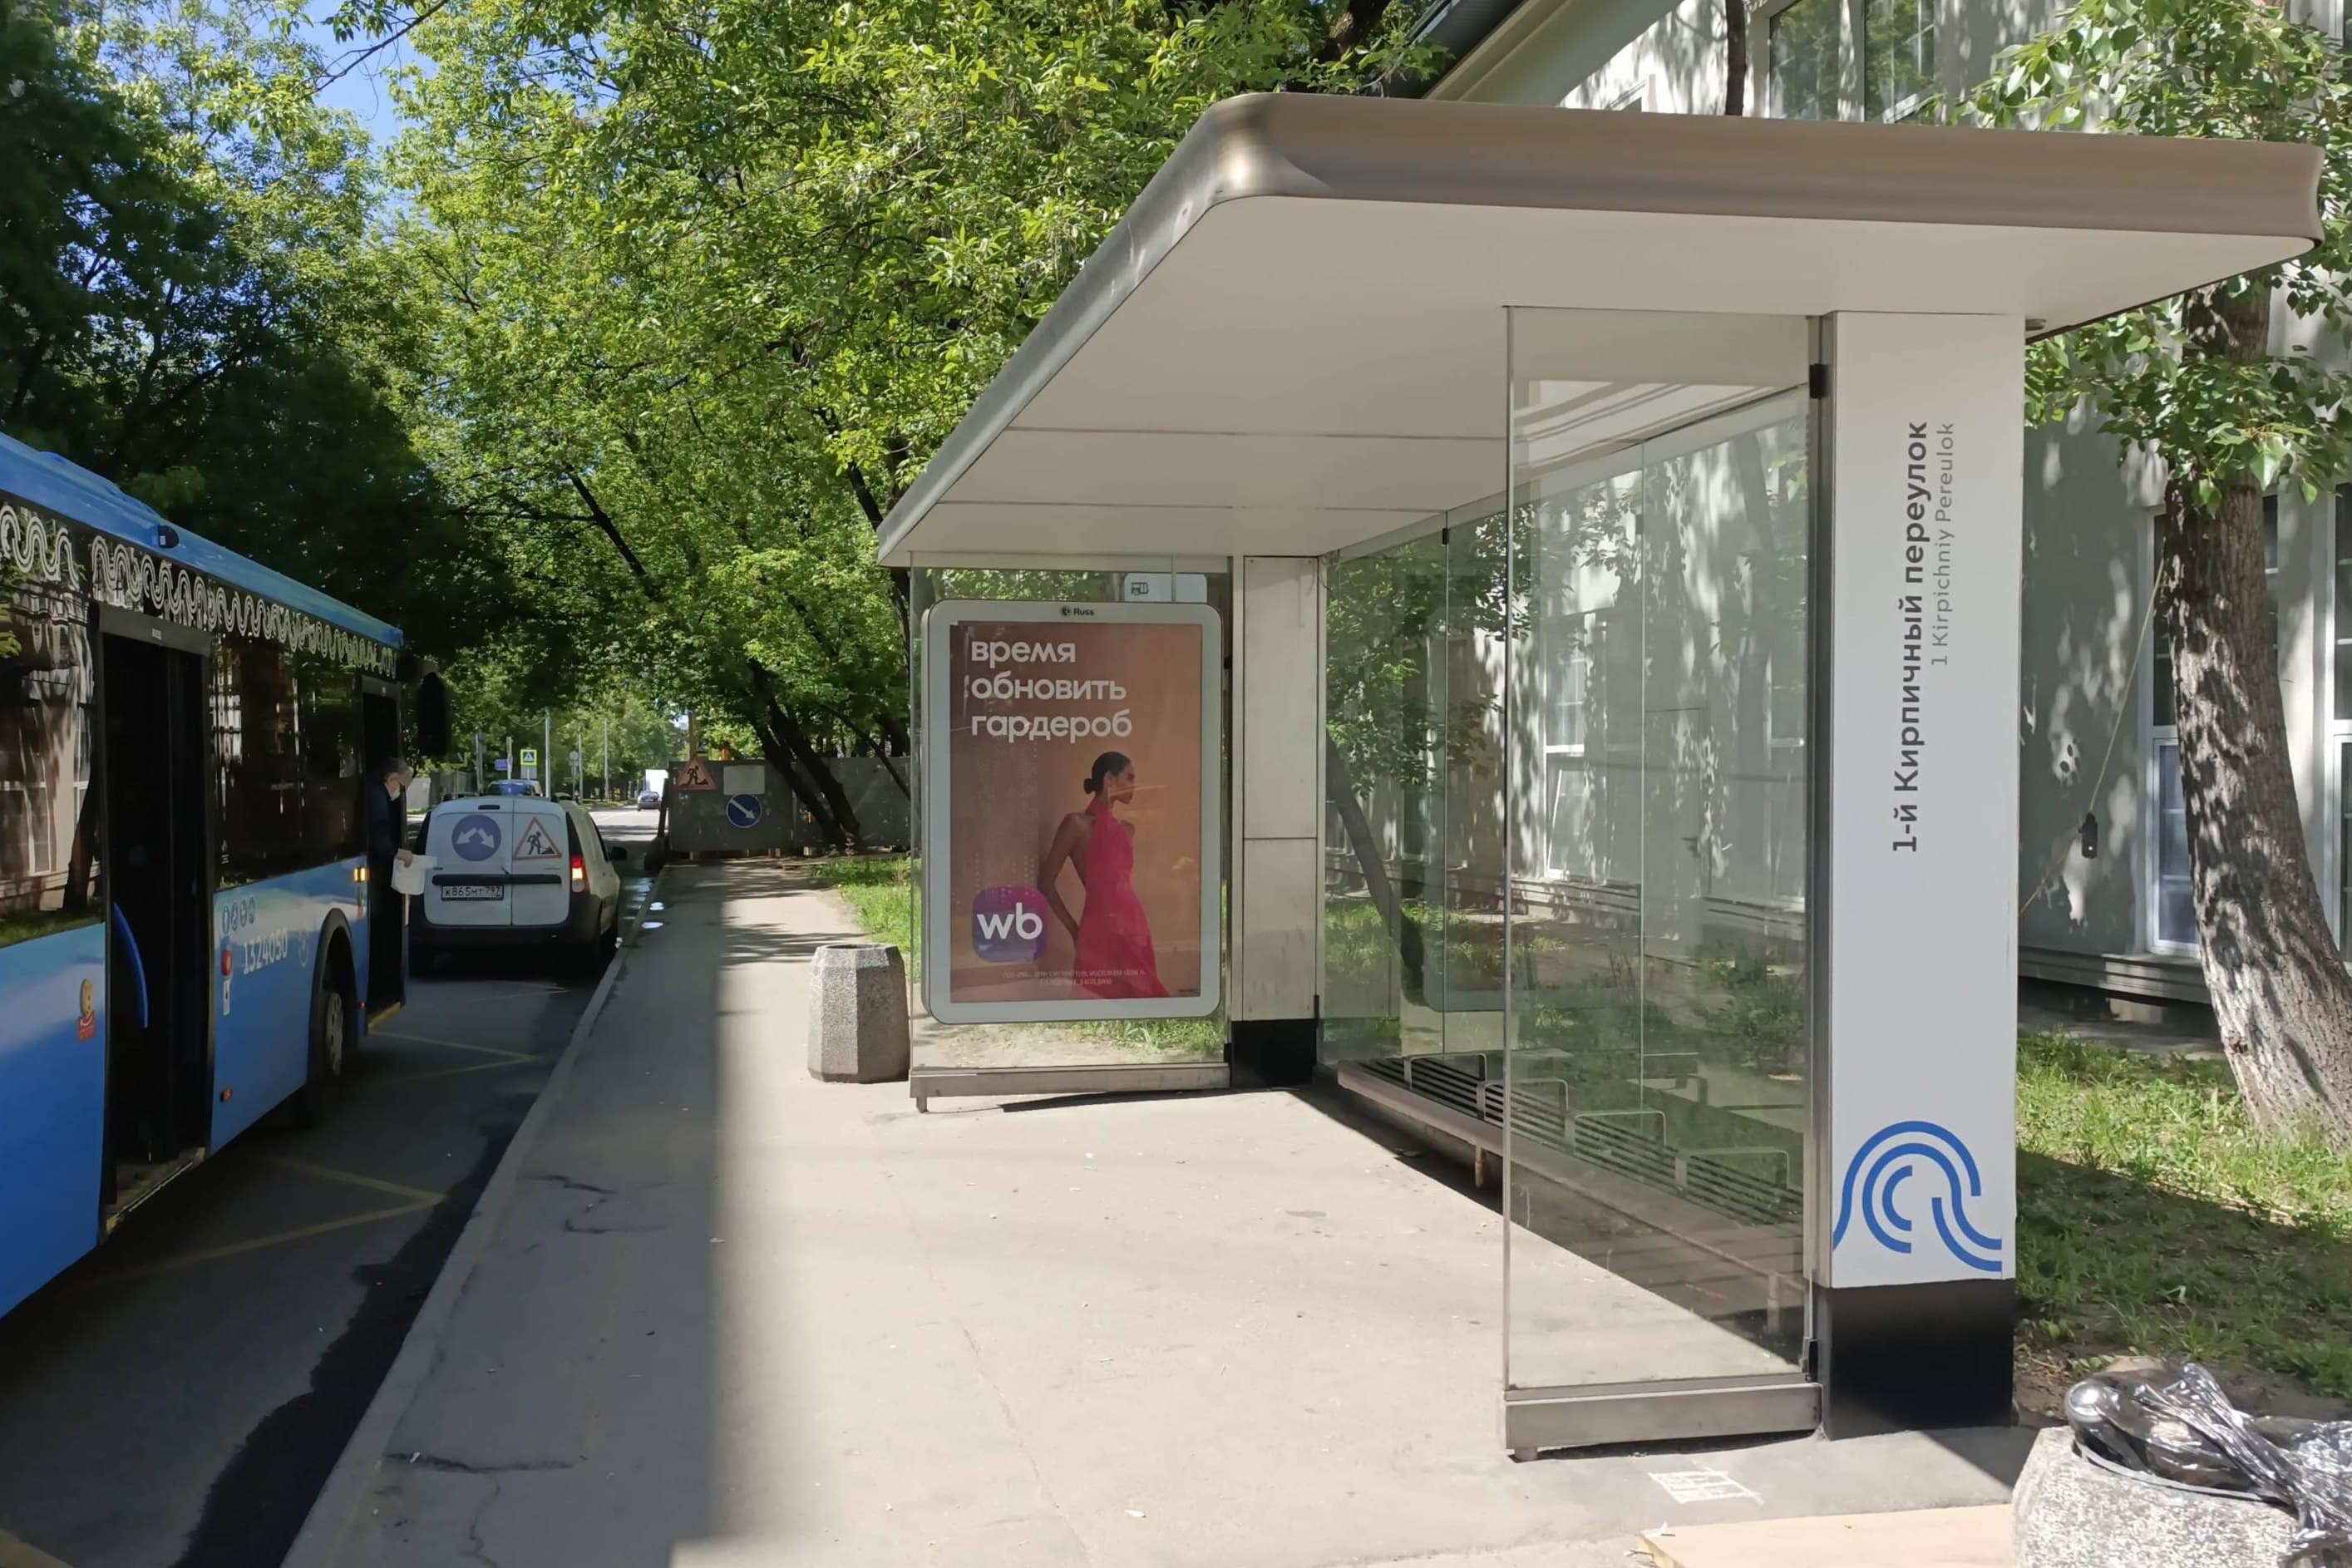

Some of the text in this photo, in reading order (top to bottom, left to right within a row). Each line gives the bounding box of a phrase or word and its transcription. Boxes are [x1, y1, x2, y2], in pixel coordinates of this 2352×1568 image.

[1930, 422, 1955, 666] 1 Kirpichniy Pereulok
[1073, 608, 1095, 616] Russ
[971, 640, 1076, 668] время
[1892, 422, 1931, 852] 1-й Кирпичный переулок
[971, 671, 1127, 701] обновить
[971, 709, 1132, 743] гардероб
[976, 901, 1043, 940] wb
